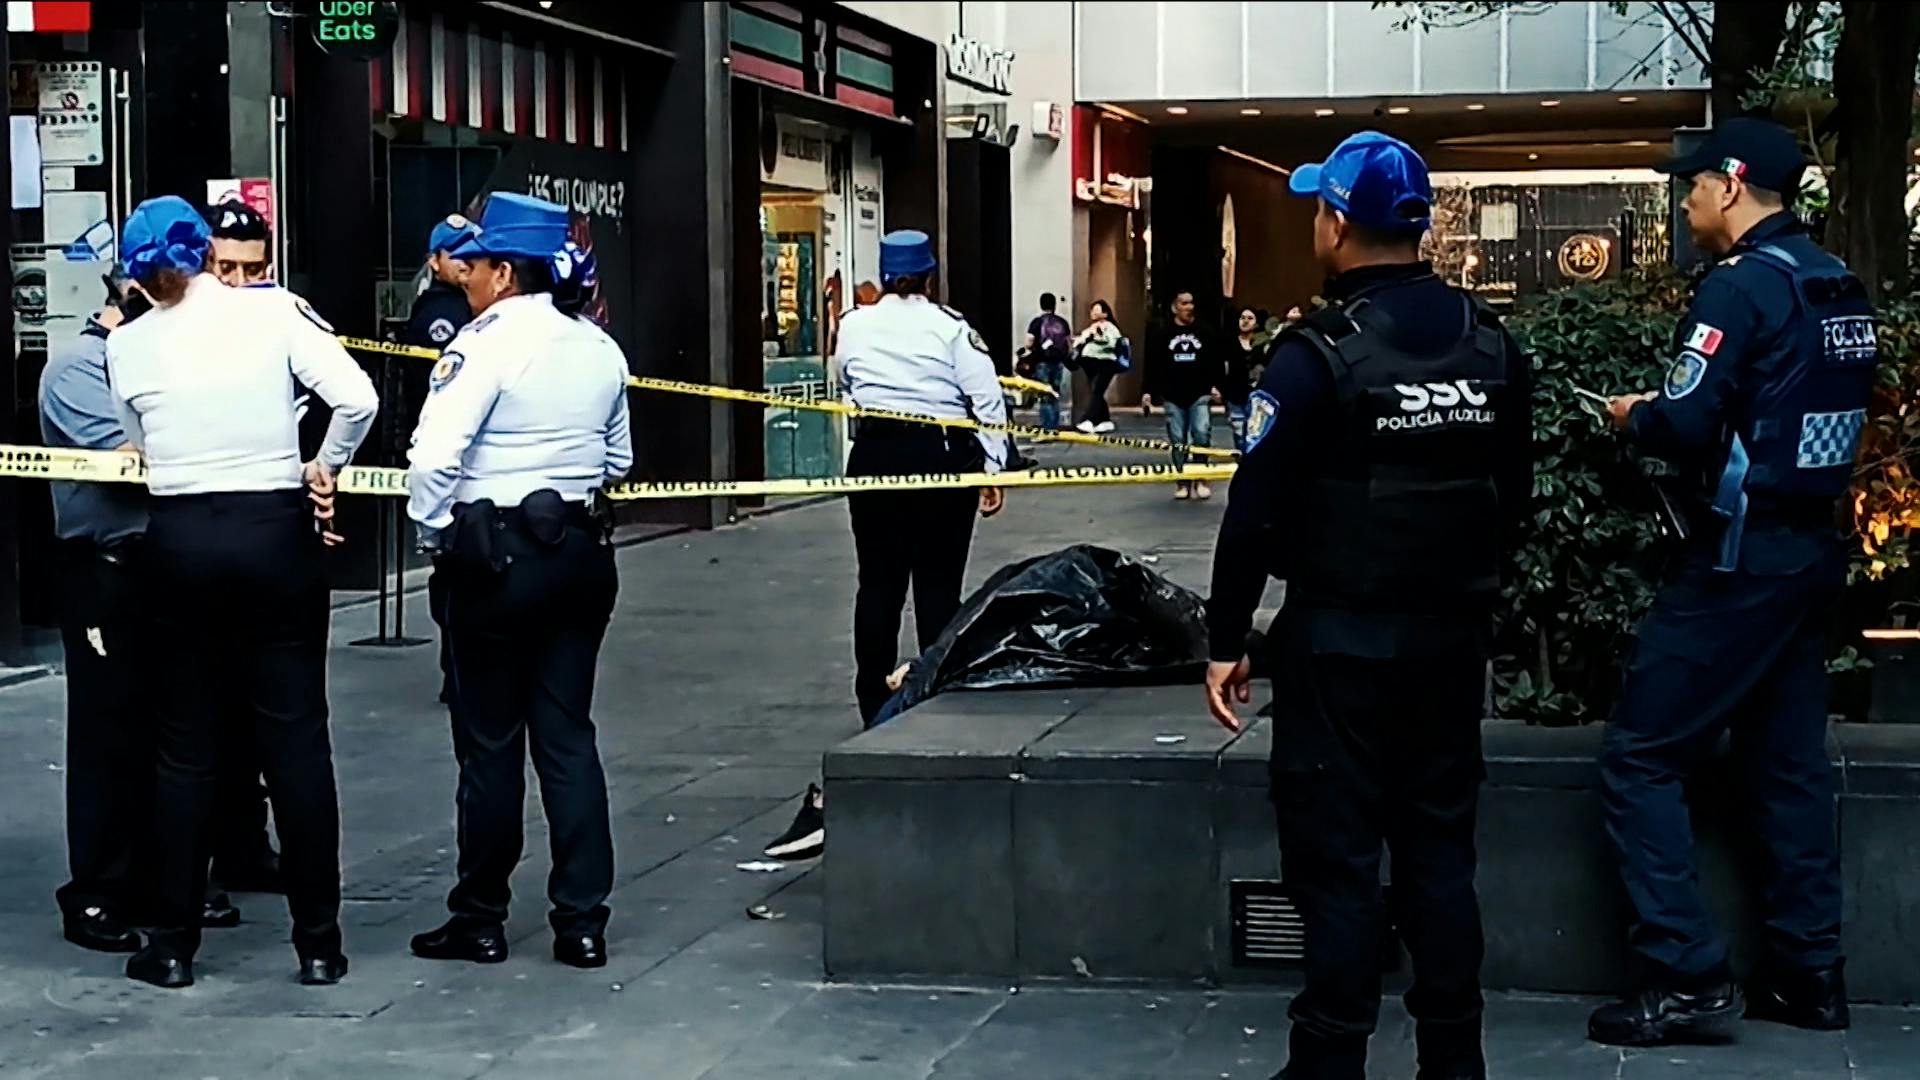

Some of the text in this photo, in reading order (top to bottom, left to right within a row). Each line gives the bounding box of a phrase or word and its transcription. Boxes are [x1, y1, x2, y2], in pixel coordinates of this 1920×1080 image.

[319, 19, 376, 40] Eats
[571, 177, 625, 218] CUMPLE?
[1393, 379, 1488, 412] SSC
